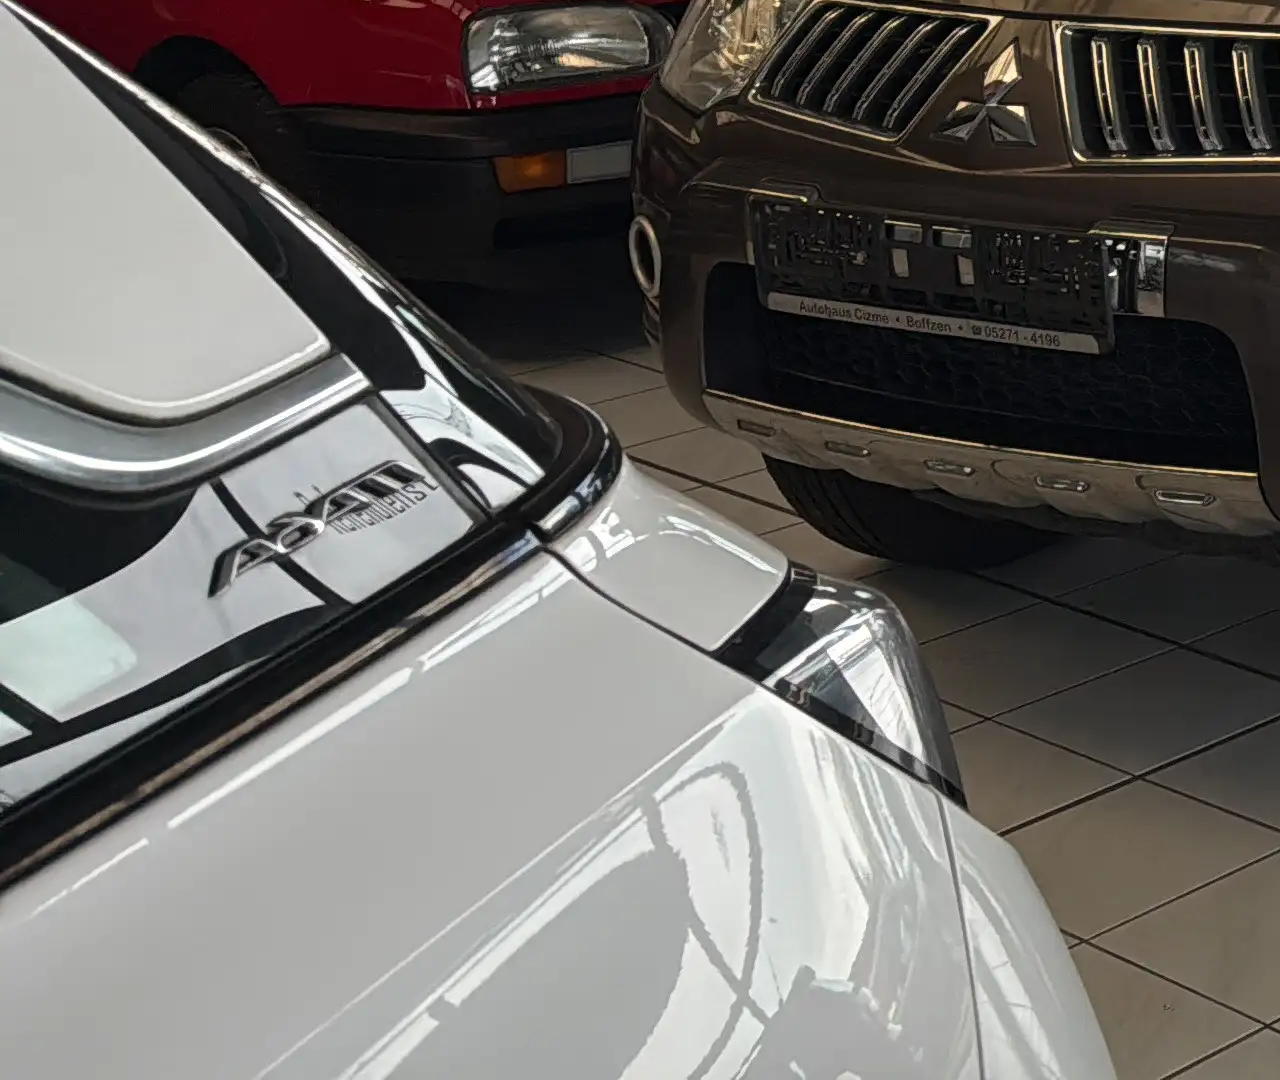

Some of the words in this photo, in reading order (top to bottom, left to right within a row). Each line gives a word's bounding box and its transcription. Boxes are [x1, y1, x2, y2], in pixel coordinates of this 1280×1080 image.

[800, 299, 851, 318] Autohaus
[906, 315, 952, 333] Boffzen
[984, 326, 1020, 342] 05271
[1029, 332, 1061, 347] 4196
